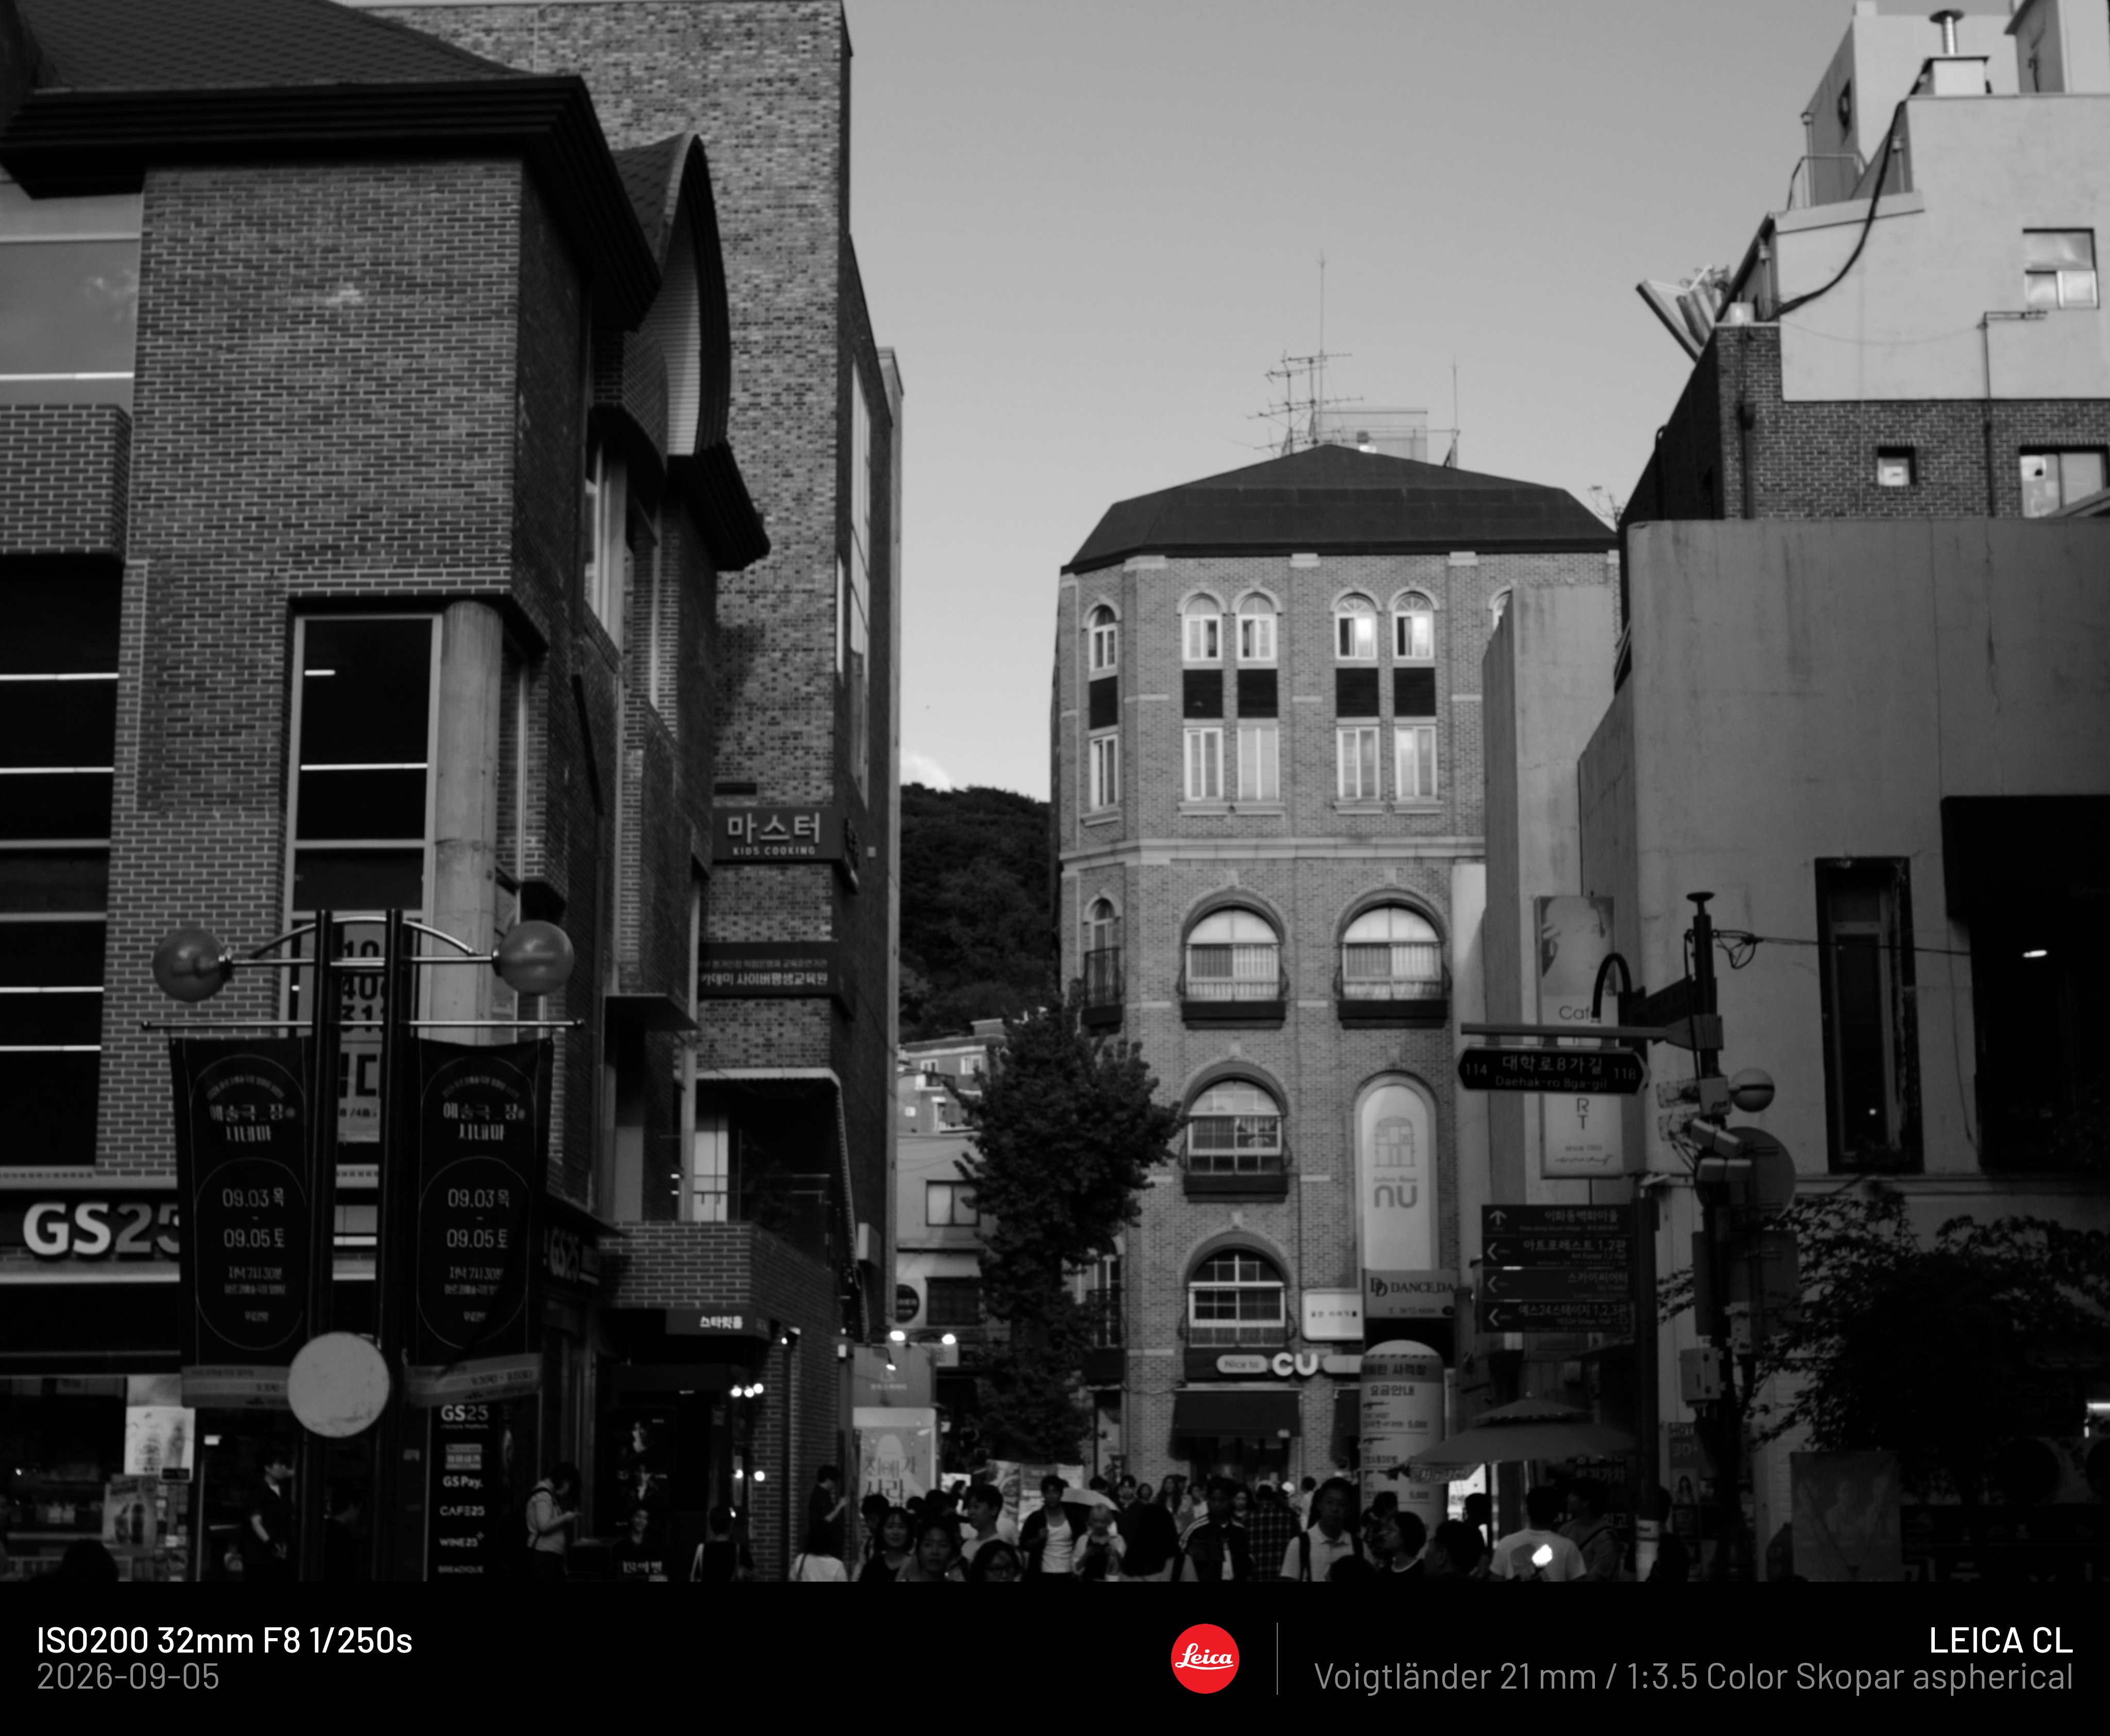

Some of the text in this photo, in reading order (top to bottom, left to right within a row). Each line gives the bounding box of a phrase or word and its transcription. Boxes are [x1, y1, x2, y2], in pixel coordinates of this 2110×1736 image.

[727, 812, 820, 844] 마스터
[733, 846, 816, 856] KIDS COOKING
[1559, 1006, 1594, 1020] Caf
[1465, 1054, 1637, 1081] 114 대학로8가길 118
[1495, 1075, 1607, 1092] Daehak-ro 8ga-gil
[222, 1188, 269, 1208] 09.03
[448, 1188, 495, 1208] 09.03
[224, 1228, 285, 1248] 09.05 토
[447, 1228, 508, 1249] 09.05 토
[1224, 1352, 1319, 1377] Nice to CU
[1370, 1385, 1415, 1397] 요금안내
[440, 1404, 489, 1422] GS25
[439, 1505, 486, 1517] CAFE25
